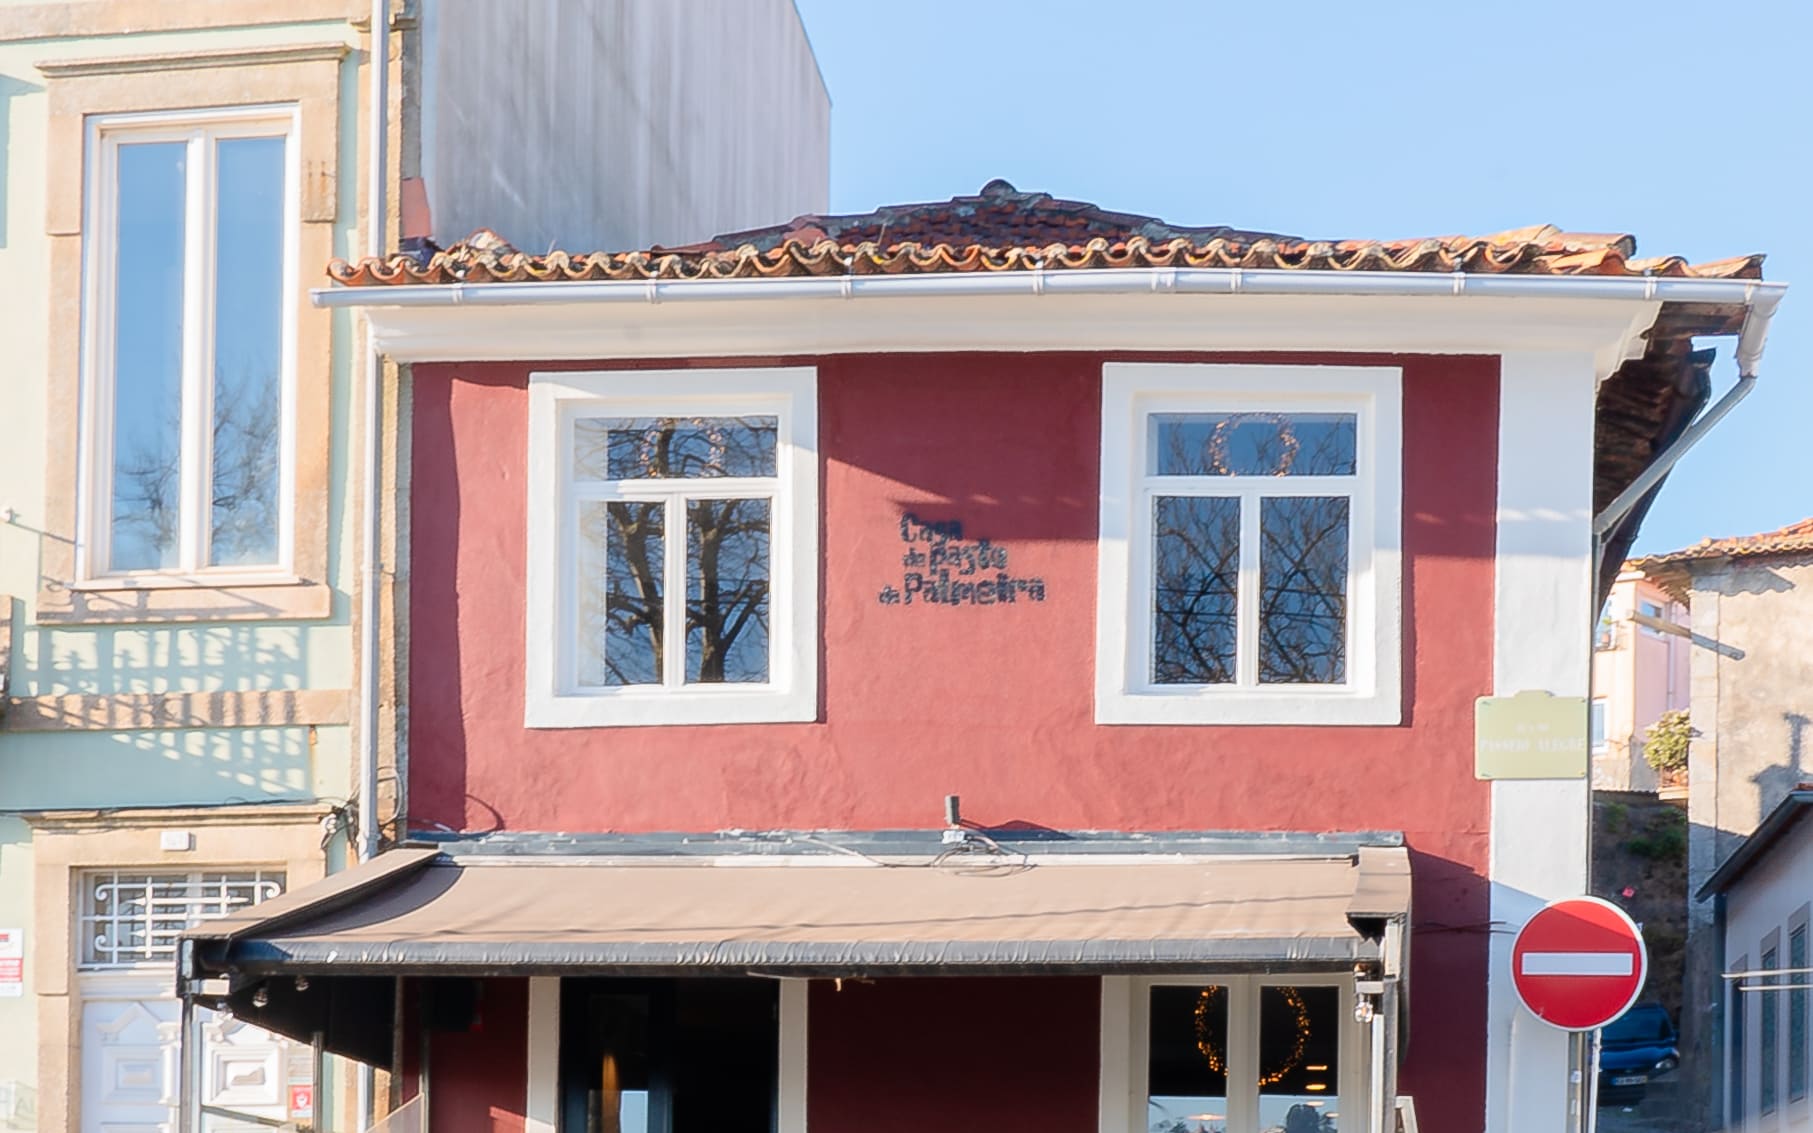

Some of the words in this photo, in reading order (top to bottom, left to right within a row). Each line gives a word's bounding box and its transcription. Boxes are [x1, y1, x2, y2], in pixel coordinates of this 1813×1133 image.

[900, 511, 963, 546] Casa
[903, 547, 925, 567] de
[904, 568, 1046, 605] Palmeira
